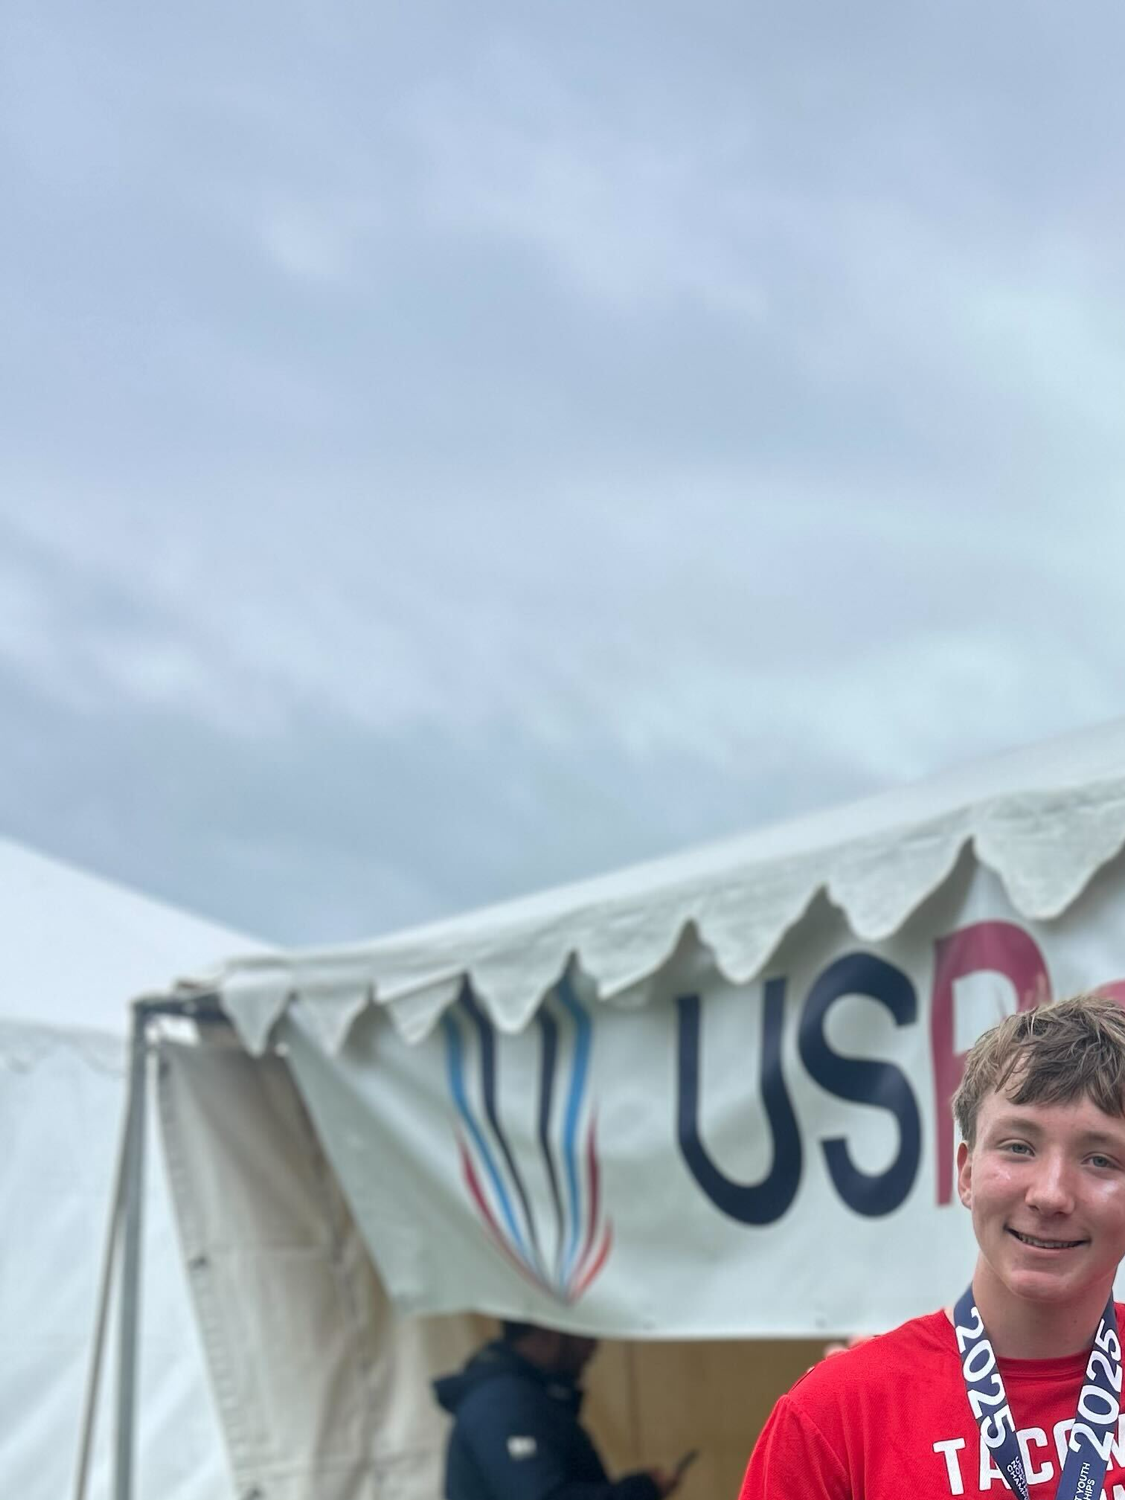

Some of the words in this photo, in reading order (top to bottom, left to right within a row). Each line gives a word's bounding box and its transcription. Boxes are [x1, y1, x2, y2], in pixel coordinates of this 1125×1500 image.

[955, 1306, 1016, 1449] 2025
[1068, 1318, 1123, 1462] 2025
[1076, 1462, 1091, 1494] YOUTH
